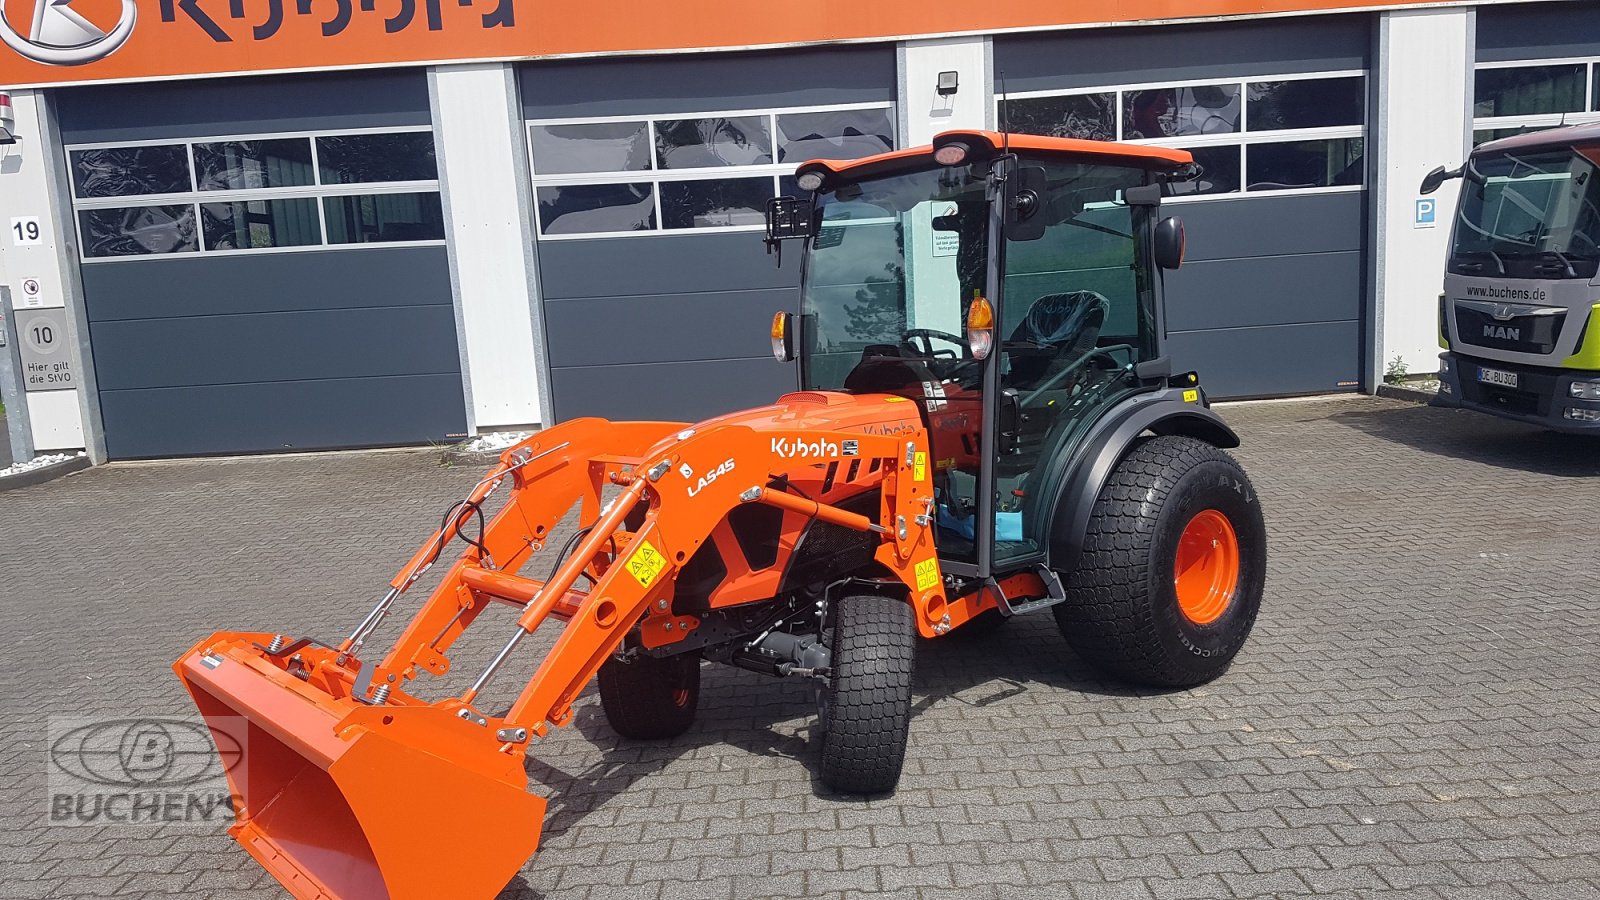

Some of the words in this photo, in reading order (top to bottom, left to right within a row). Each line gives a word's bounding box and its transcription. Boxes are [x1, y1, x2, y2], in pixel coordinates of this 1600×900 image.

[1418, 201, 1433, 221] P
[14, 221, 39, 241] 19
[1466, 285, 1546, 301] www.buchens.de
[33, 326, 53, 344] 10
[1483, 325, 1520, 341] MAN
[28, 362, 48, 372] Hier
[53, 361, 69, 373] gilt
[30, 374, 44, 384] die
[47, 372, 71, 383] StVO
[771, 437, 838, 458] Kubota
[687, 458, 735, 497] LA545
